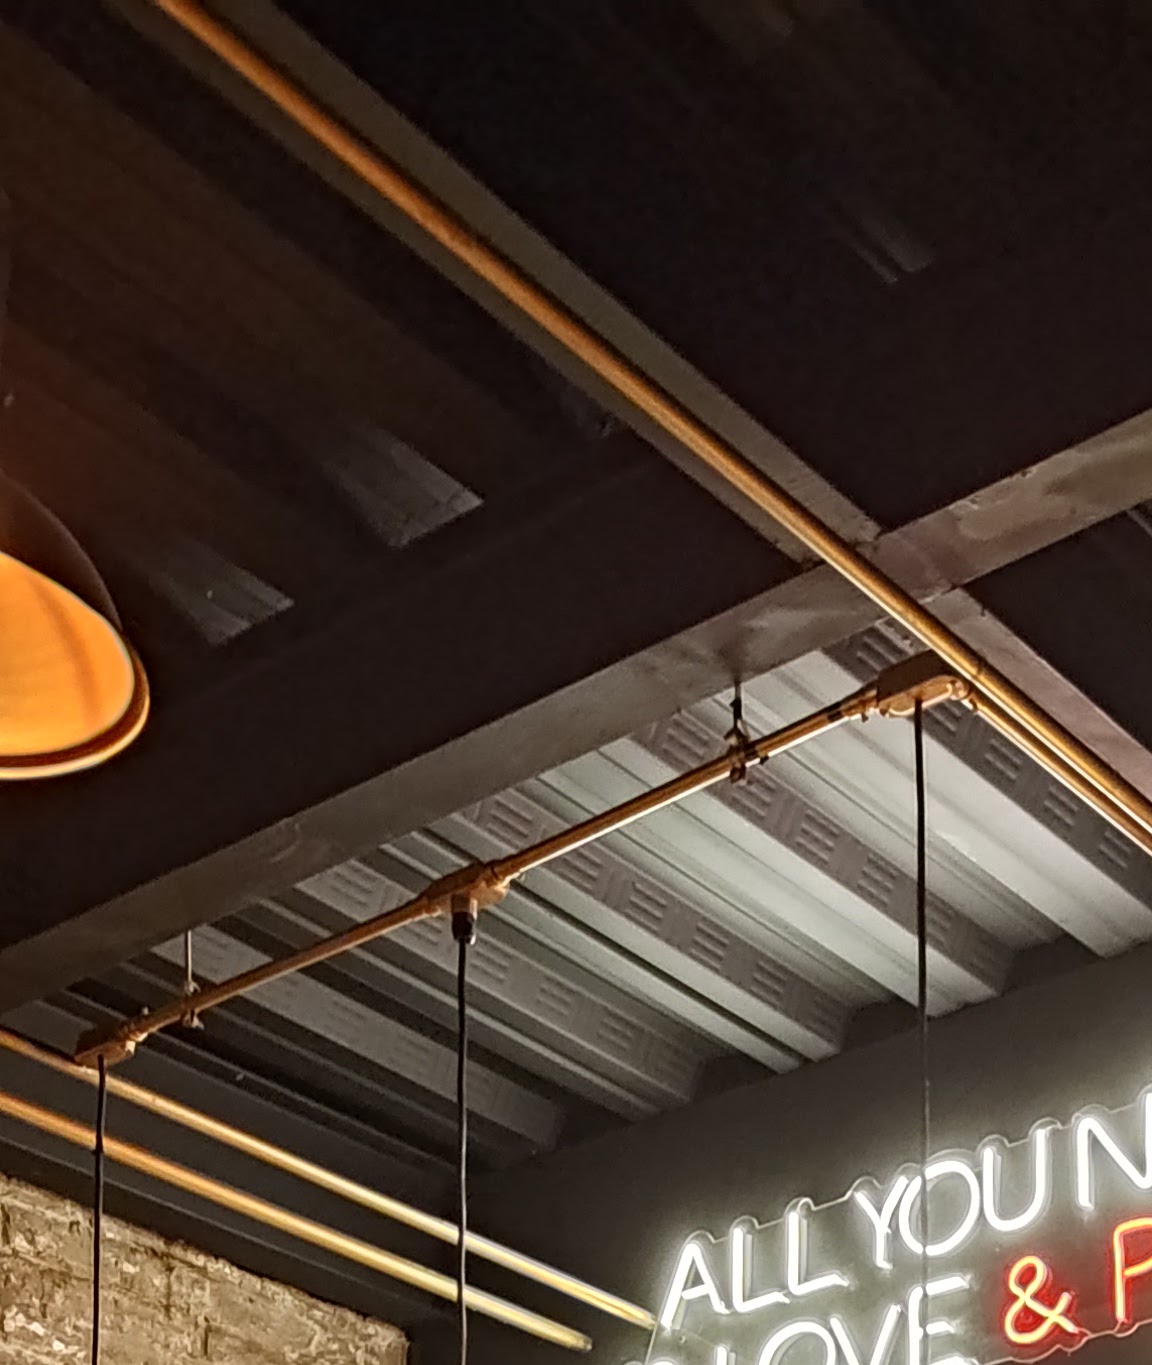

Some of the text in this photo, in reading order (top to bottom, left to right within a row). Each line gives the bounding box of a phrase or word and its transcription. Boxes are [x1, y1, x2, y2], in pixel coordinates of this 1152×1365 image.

[659, 1202, 848, 1331] ALL
[853, 1122, 1052, 1270] YOU
[1002, 1255, 1079, 1345] &
